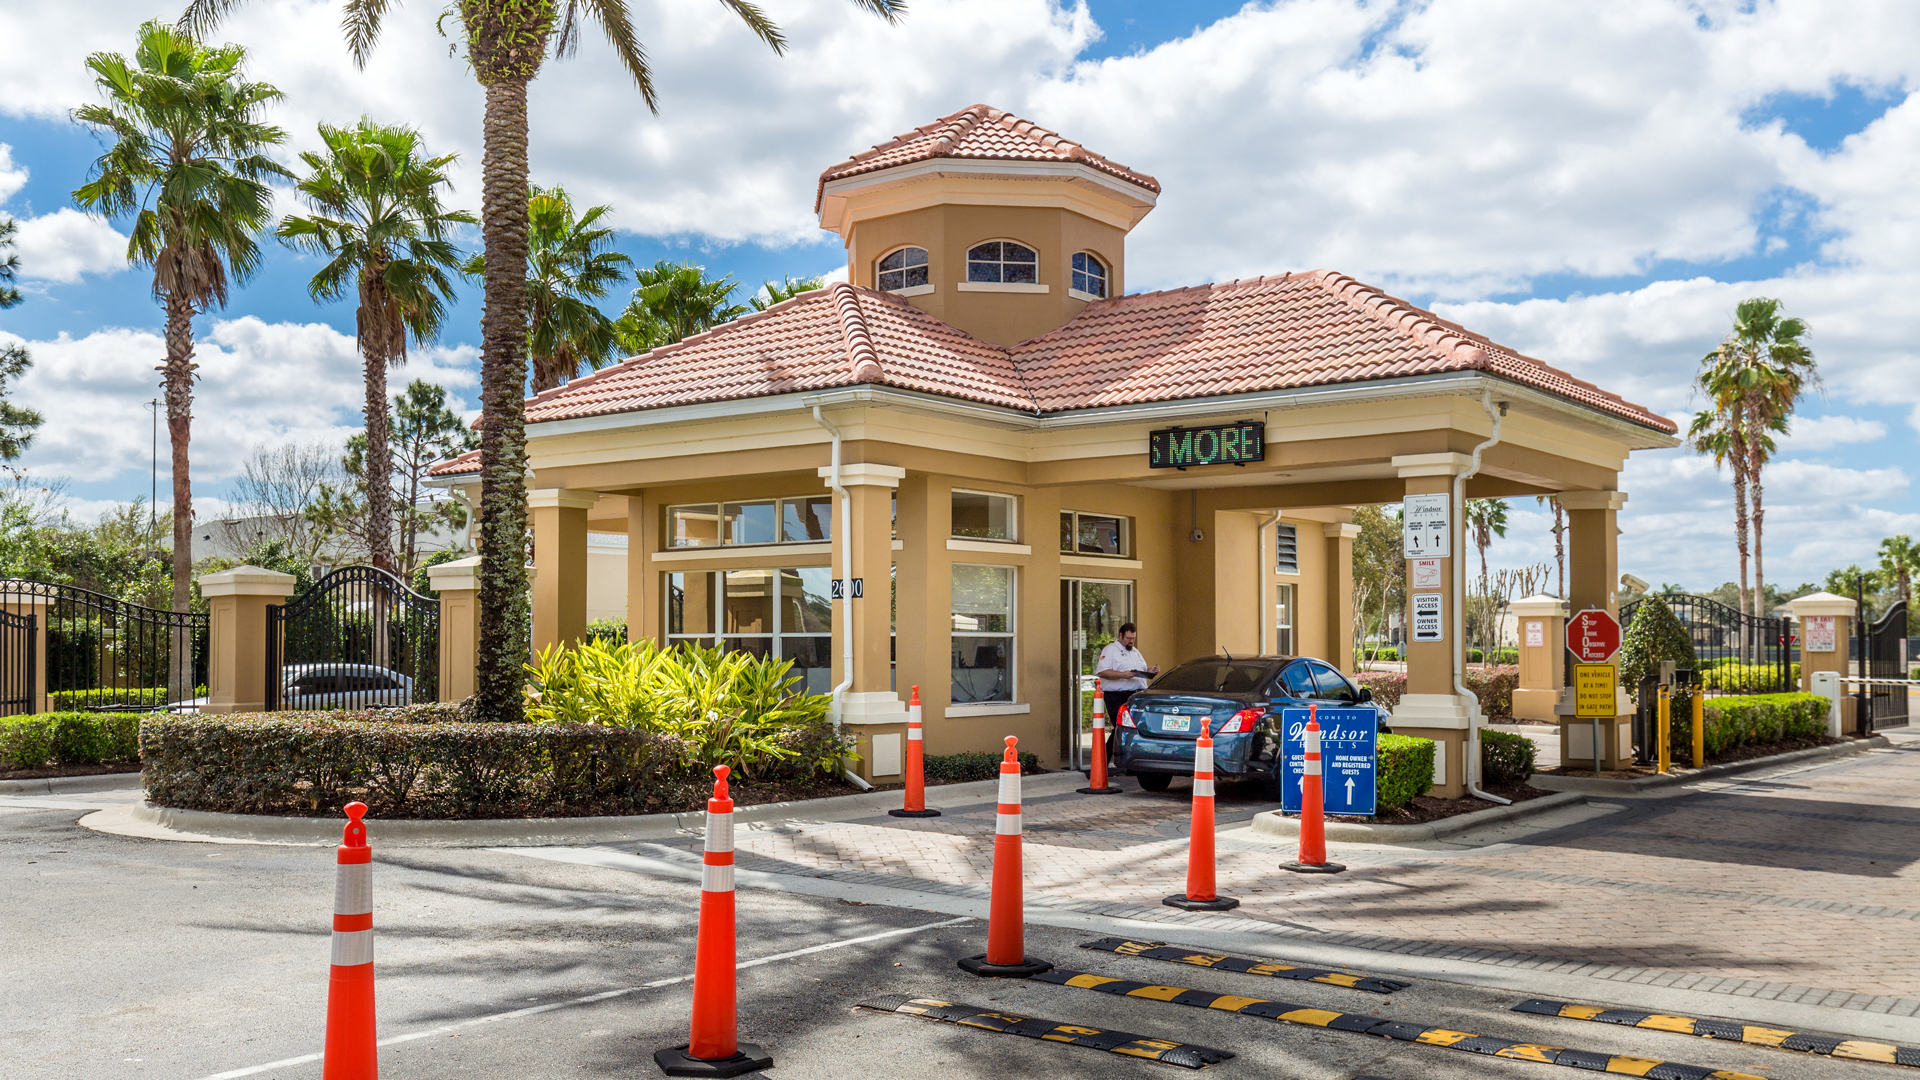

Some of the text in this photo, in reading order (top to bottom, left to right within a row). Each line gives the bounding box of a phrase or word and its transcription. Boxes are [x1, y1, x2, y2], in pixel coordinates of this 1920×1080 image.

[1169, 426, 1253, 464] MORE
[1414, 504, 1442, 513] Windsor
[1289, 722, 1368, 741] Wndsor
